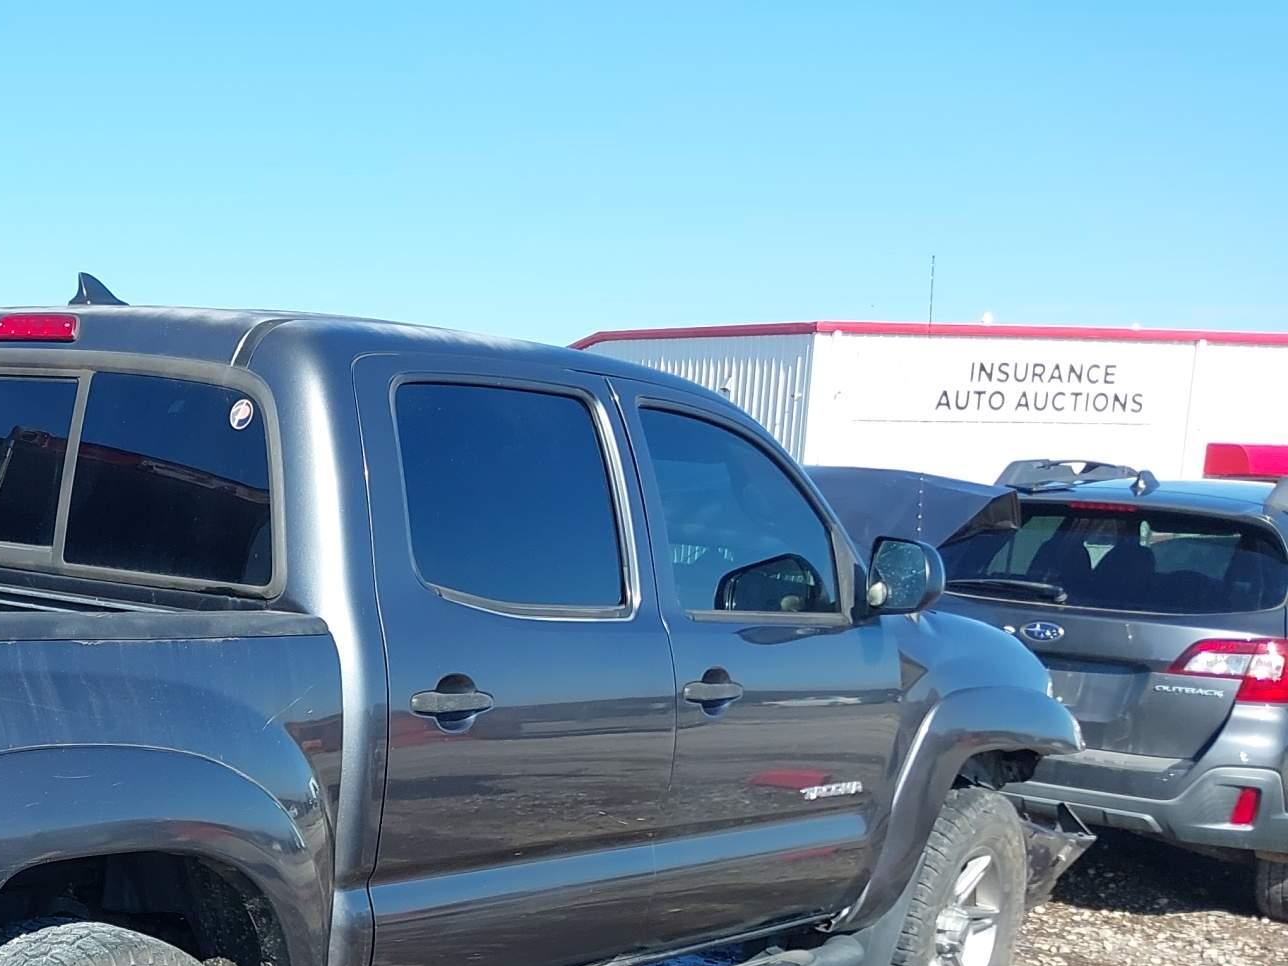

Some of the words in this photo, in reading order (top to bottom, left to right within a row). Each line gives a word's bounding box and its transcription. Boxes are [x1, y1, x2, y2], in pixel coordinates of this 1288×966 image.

[970, 362, 1117, 385] INSURANCE
[935, 390, 1006, 411] AUTO
[1014, 391, 1144, 413] AUCTIONS
[1154, 684, 1225, 698] OUTBACK
